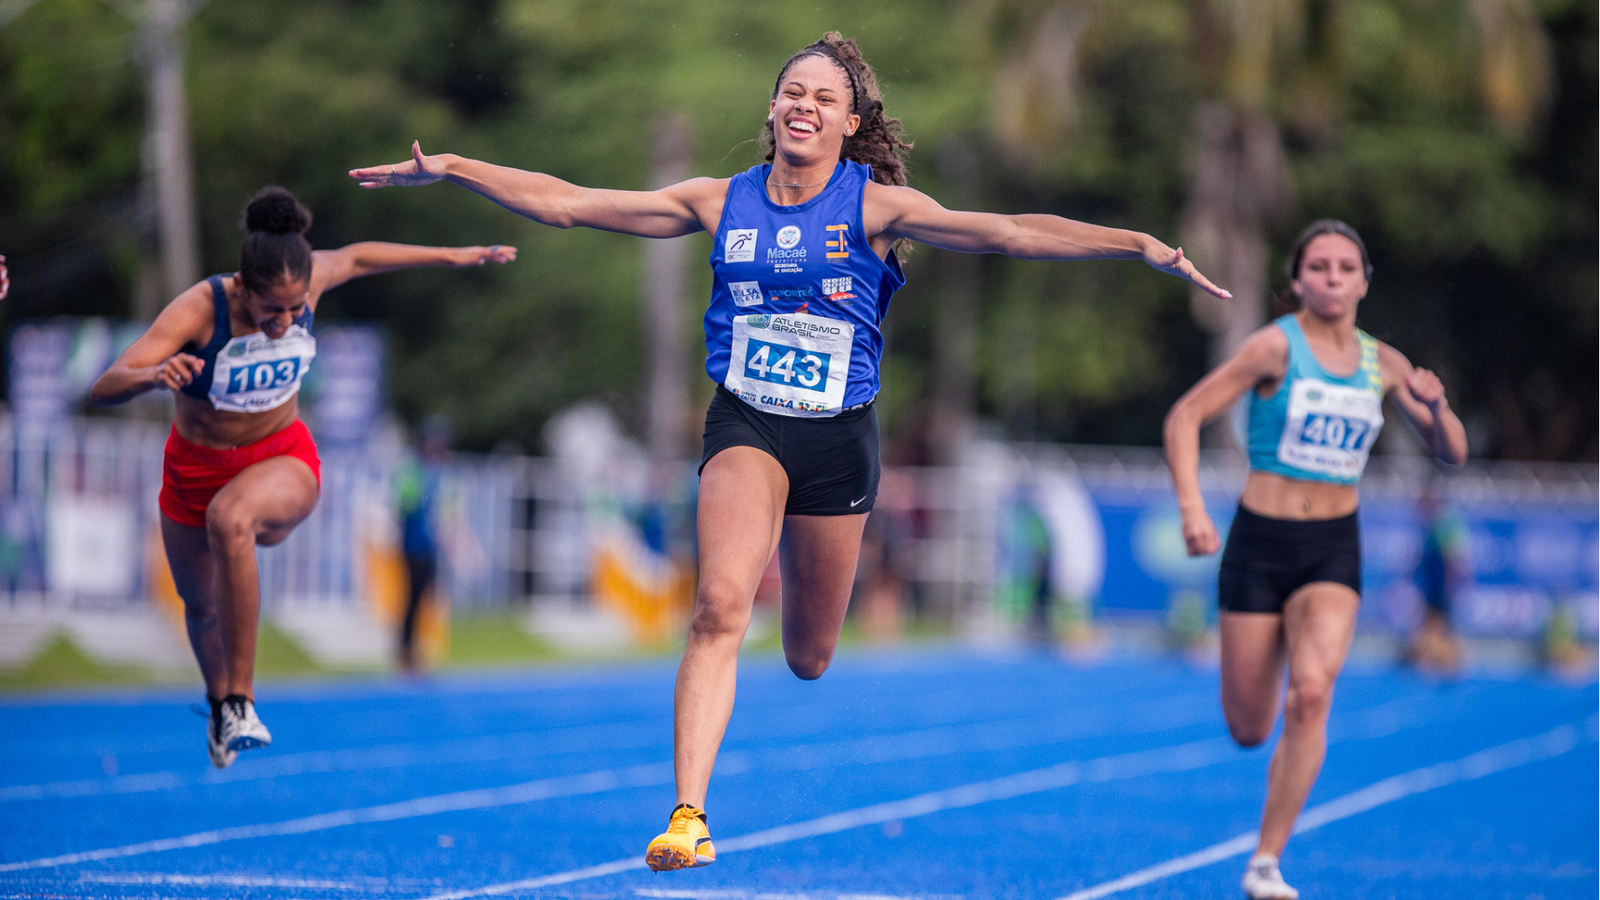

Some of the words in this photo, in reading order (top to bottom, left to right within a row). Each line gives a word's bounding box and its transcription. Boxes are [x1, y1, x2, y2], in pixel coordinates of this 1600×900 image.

[767, 246, 807, 259] Macaé
[733, 288, 760, 298] BOLSA
[768, 289, 813, 298] ESPORTES
[771, 324, 815, 339] BRASIL
[773, 317, 840, 335] ATLETISMO
[748, 345, 822, 387] 443
[234, 360, 295, 392] 103
[760, 395, 794, 409] CAIXA
[1304, 417, 1367, 449] 407
